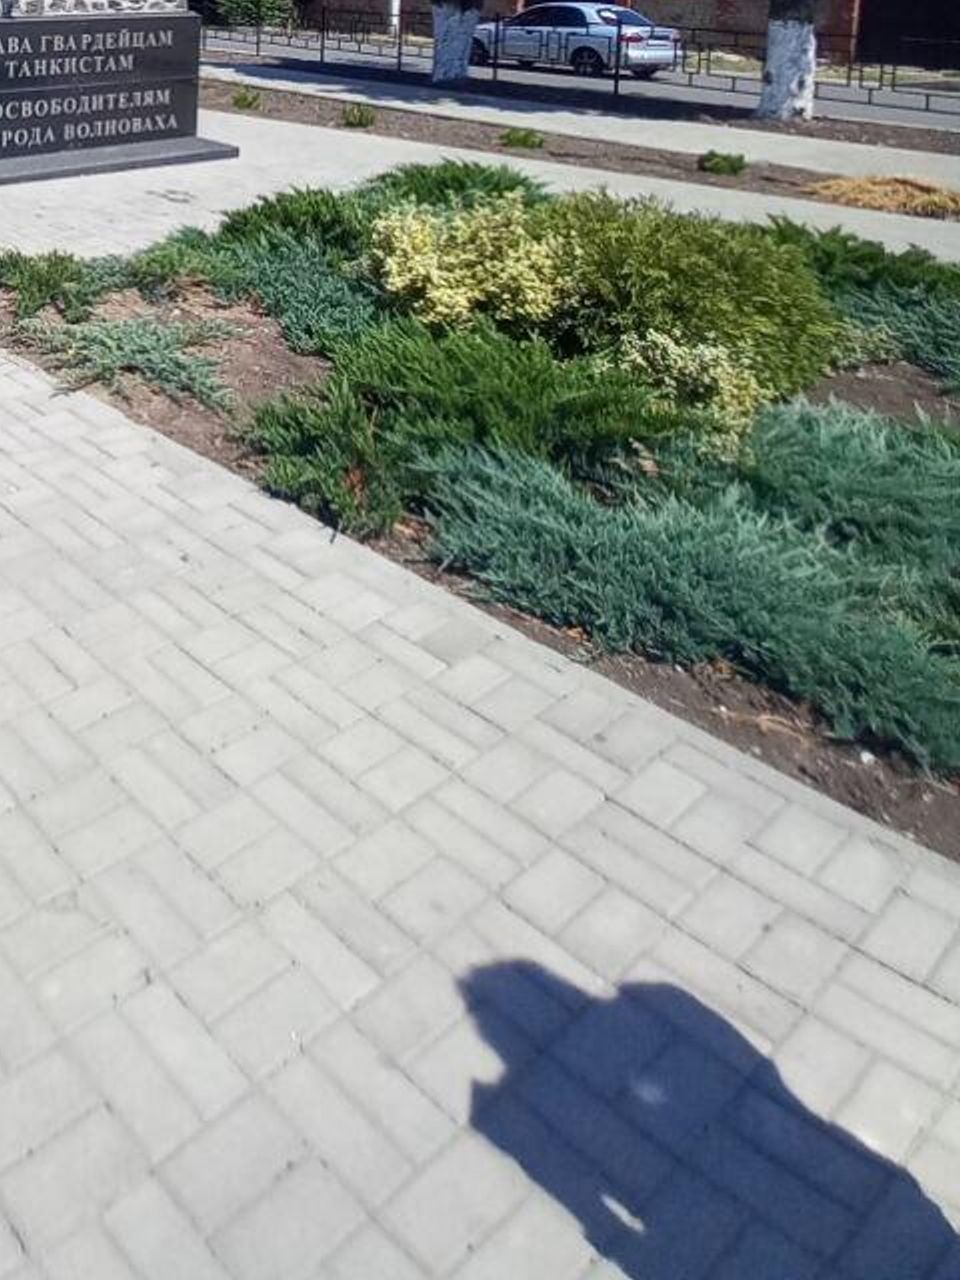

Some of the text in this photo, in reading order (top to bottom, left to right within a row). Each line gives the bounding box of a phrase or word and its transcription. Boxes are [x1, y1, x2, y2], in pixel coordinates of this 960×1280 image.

[40, 29, 173, 52] ГВАРДЕЙЦАМ
[5, 54, 134, 78] ТАНКИСТАМ
[64, 114, 178, 141] ВОЛНОВАХА
